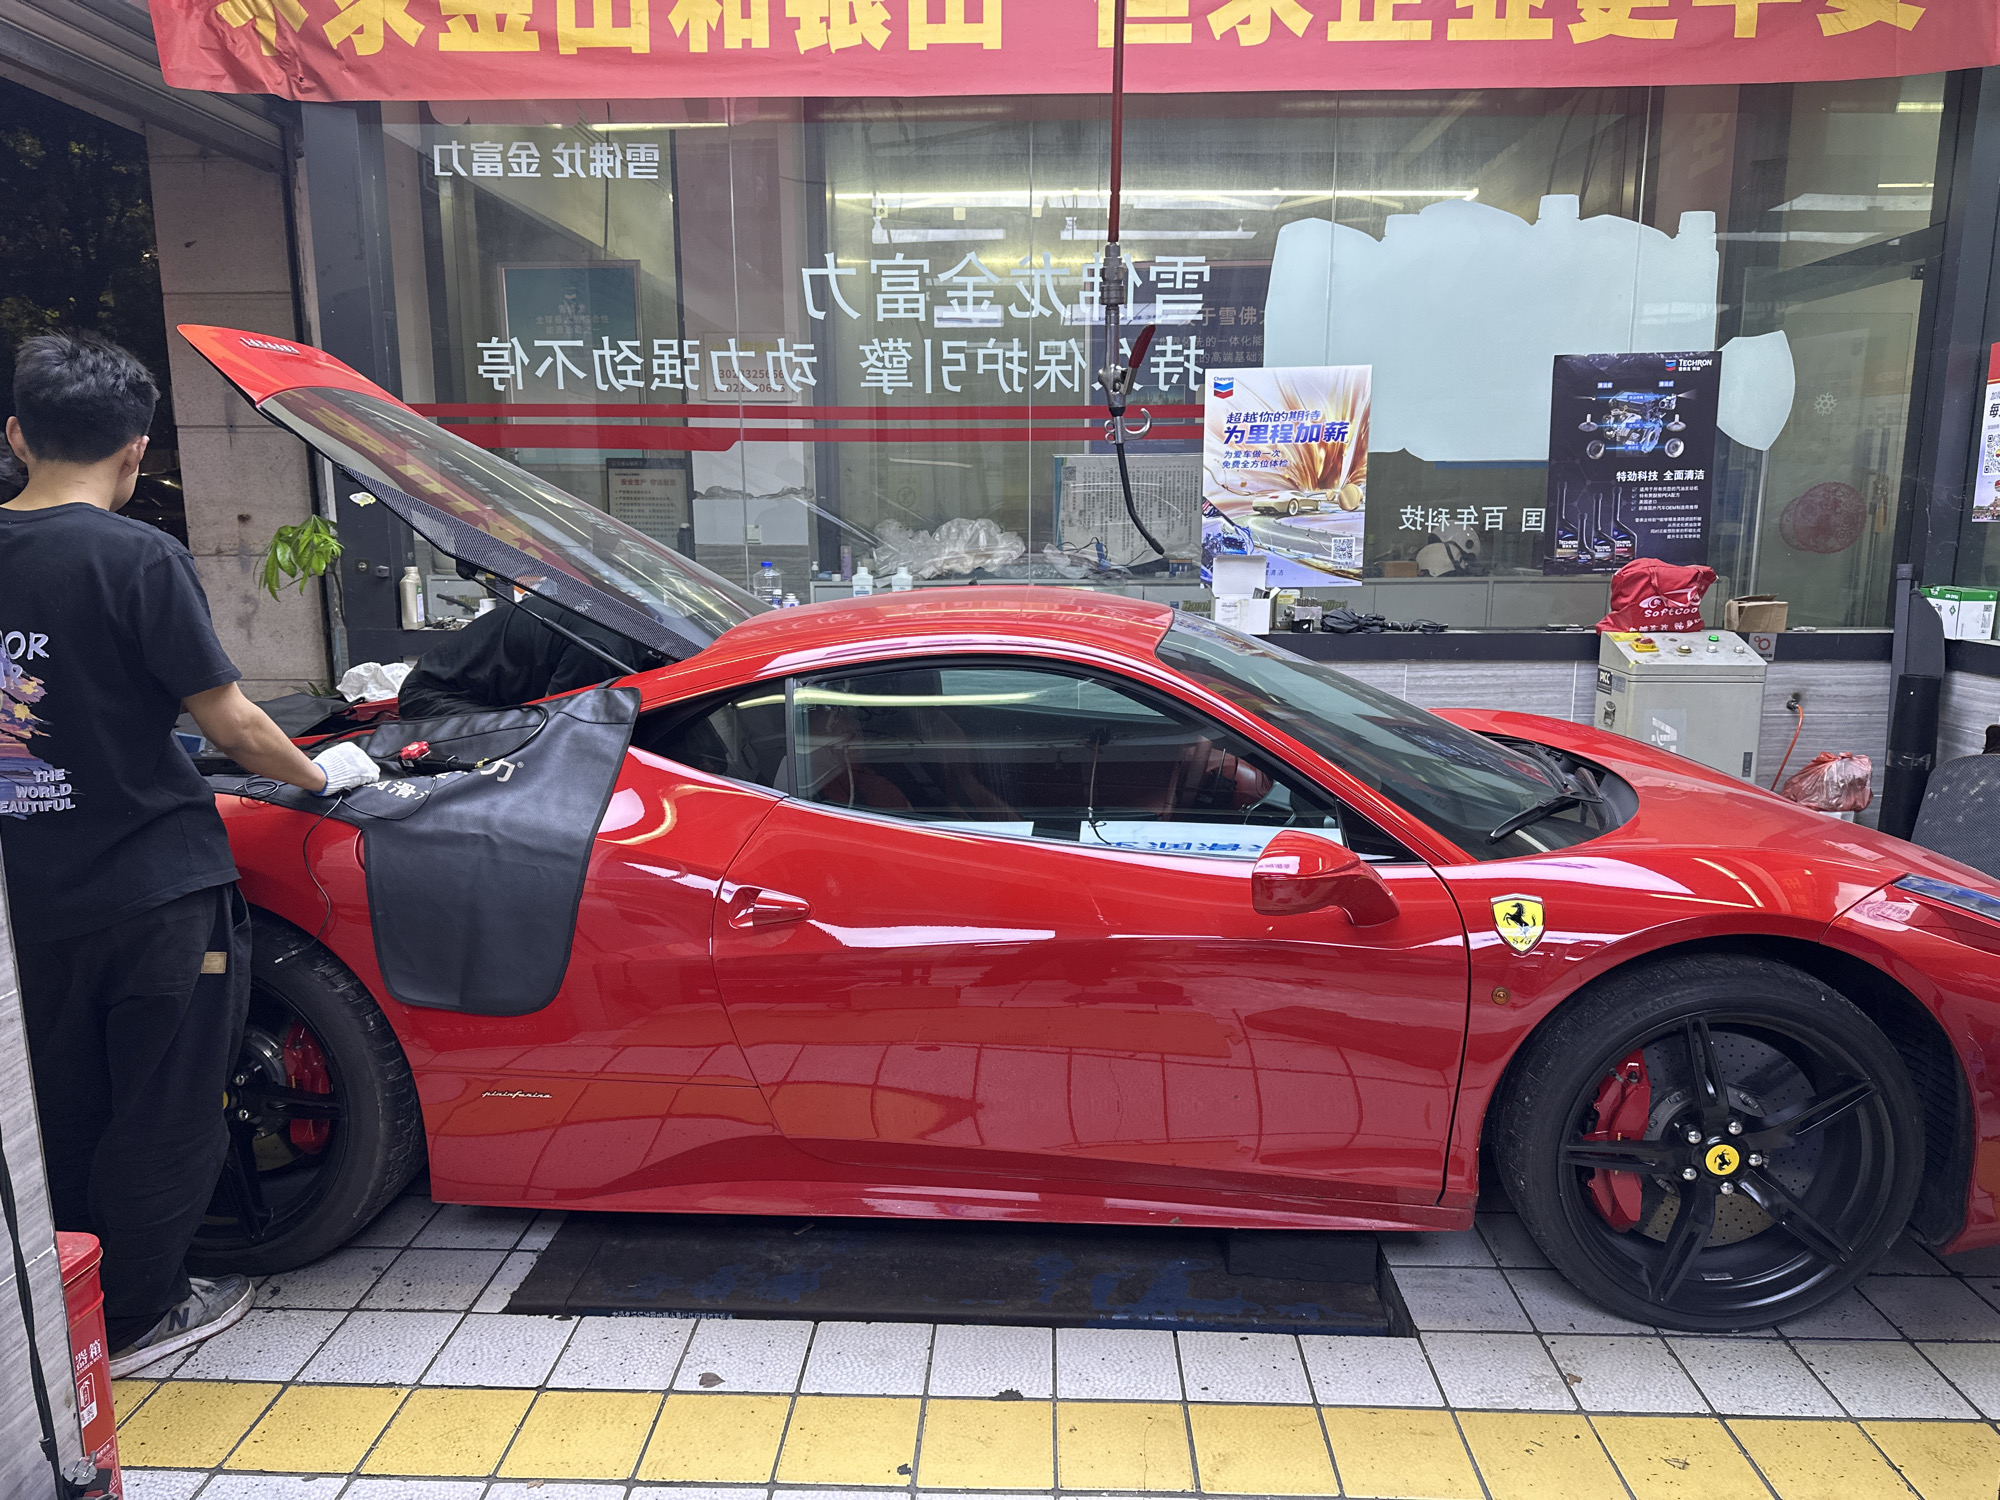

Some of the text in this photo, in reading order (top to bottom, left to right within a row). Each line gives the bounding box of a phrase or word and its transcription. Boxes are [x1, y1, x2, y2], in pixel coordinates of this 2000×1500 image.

[1678, 358, 1713, 368] TECHRON
[1226, 410, 1321, 424] 超越你的期待
[1223, 449, 1281, 459] 为爱车做一次
[1222, 459, 1288, 469] 免费全方位体检
[1616, 469, 1705, 482] 特劲科技 全面清洁
[33, 768, 66, 783] THE
[15, 783, 72, 799] WORLD
[481, 1089, 553, 1099] pininfarina
